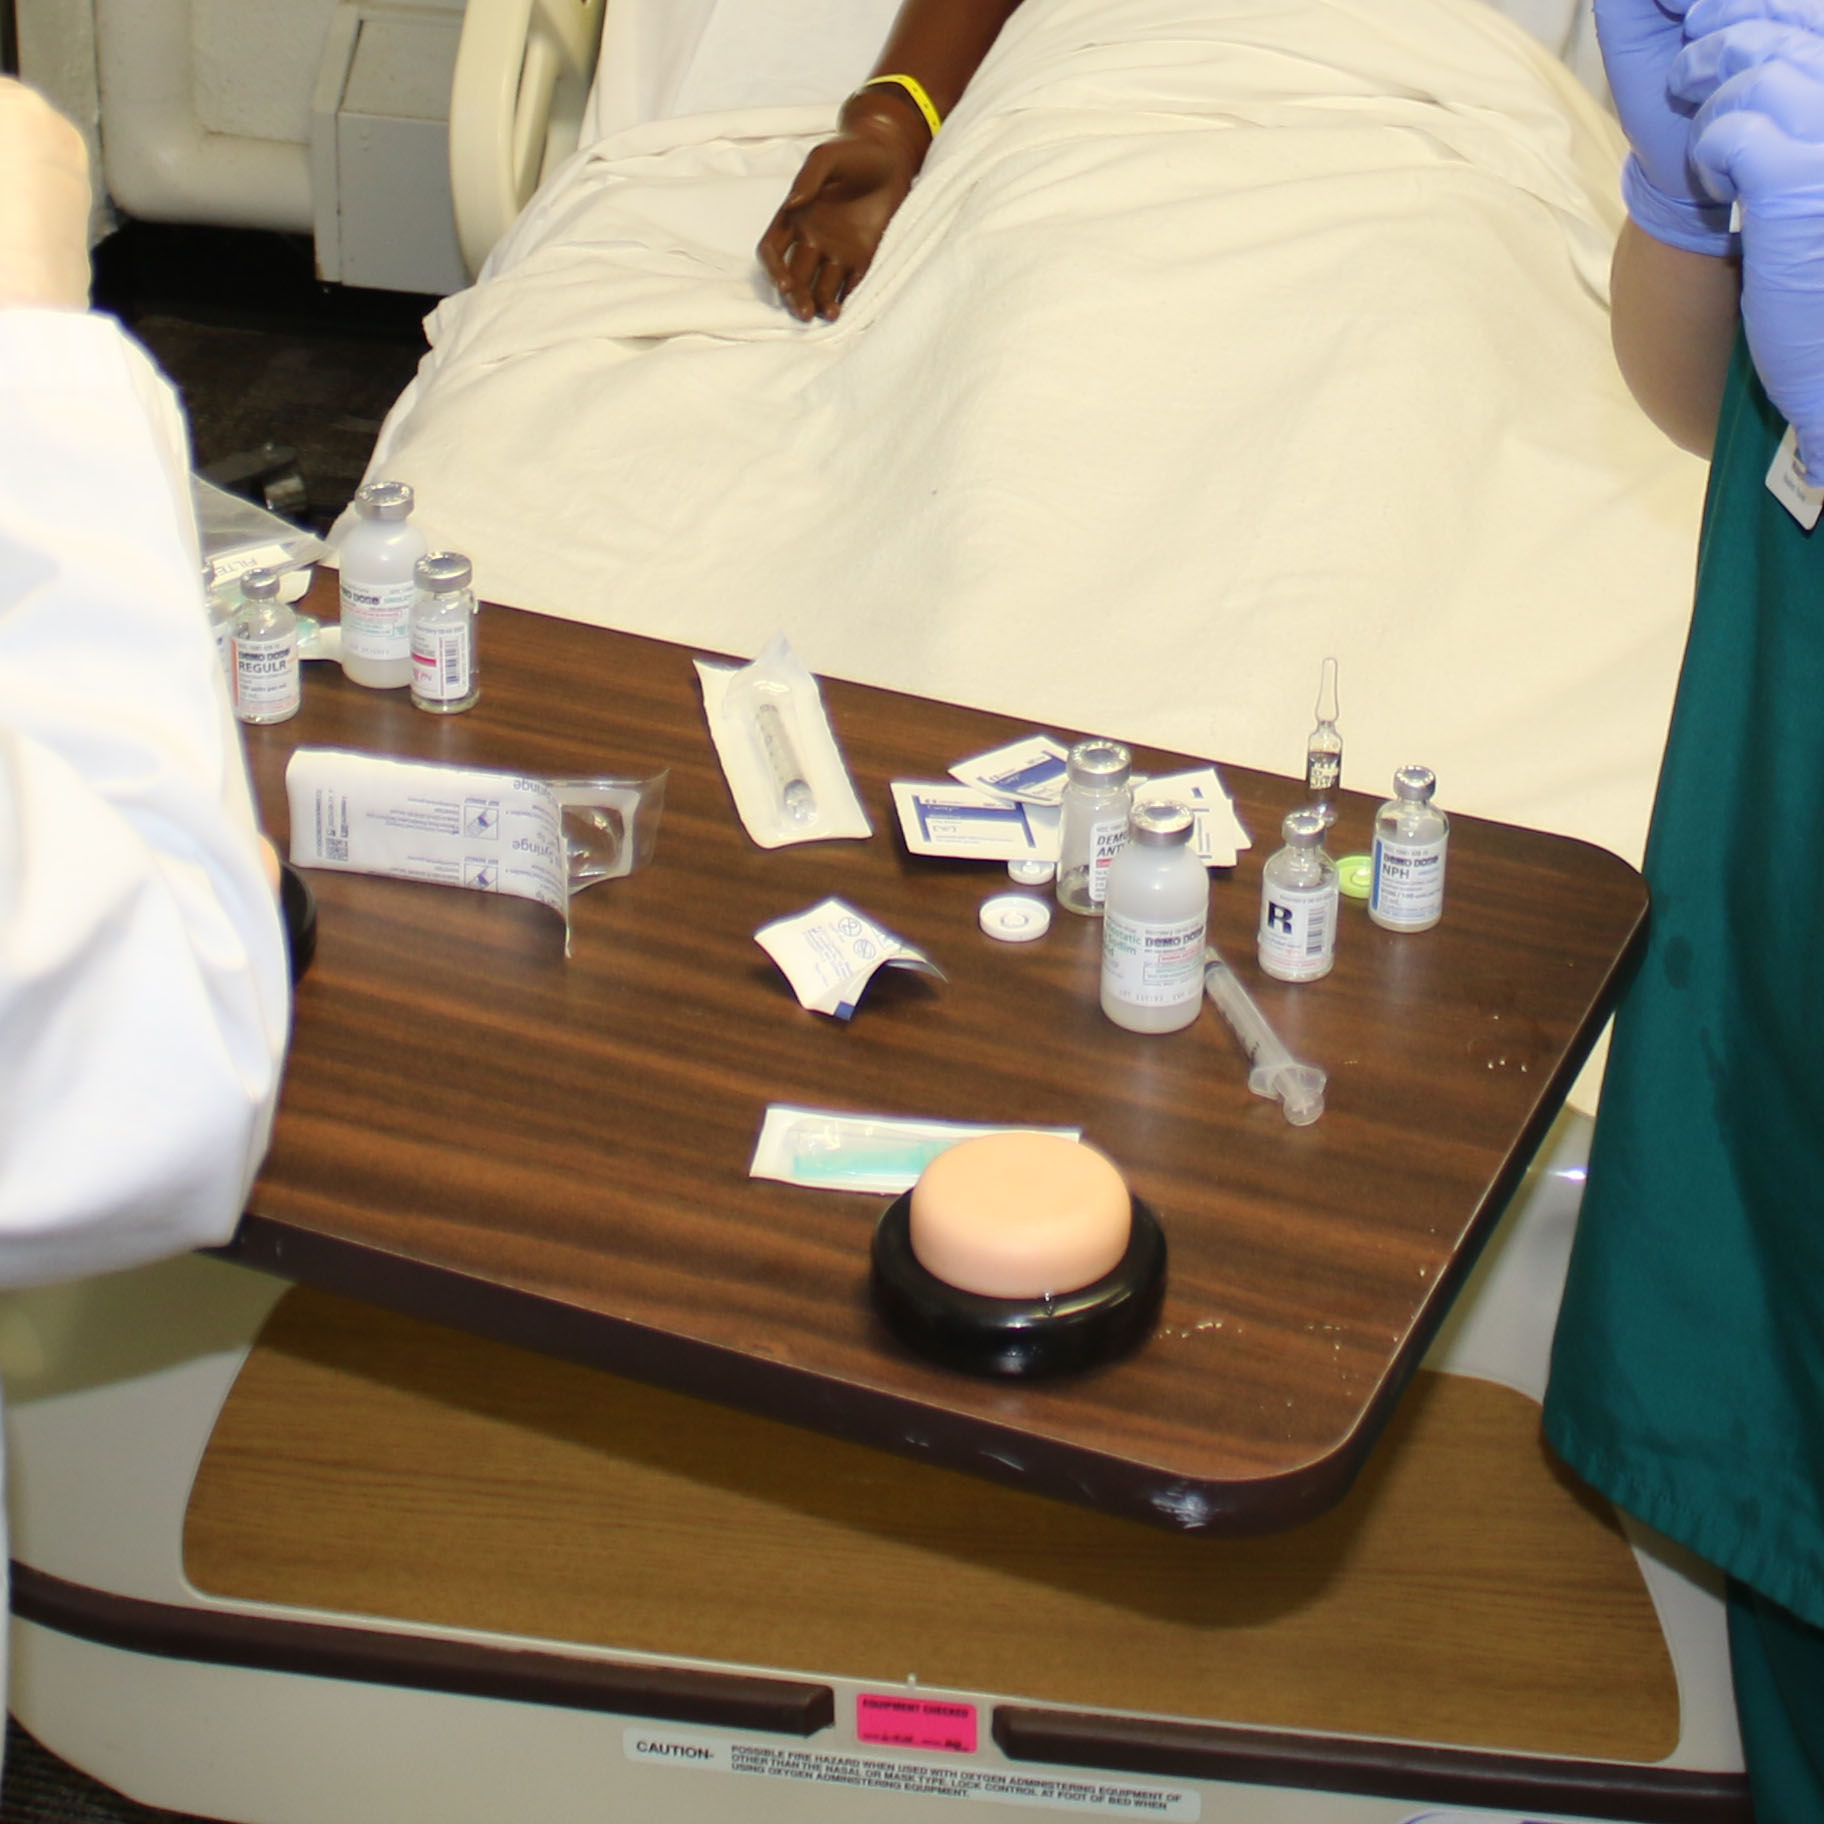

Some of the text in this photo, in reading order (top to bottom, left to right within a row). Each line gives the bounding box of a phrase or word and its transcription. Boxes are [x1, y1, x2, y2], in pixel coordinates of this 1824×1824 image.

[214, 557, 257, 578] FILTE
[238, 659, 287, 674] REGULR
[1382, 863, 1410, 880] NPH
[1267, 900, 1294, 935] R
[635, 1740, 715, 1761] CAUTION-
[731, 1744, 1182, 1803] POSSIBLE FIRE HAZARD WHEN USED WITH OXYGEN ADMINISTERING EQUIPMENT OF
[731, 1763, 971, 1799] USING OXYGEN ADMINISTERING EQUIPMENT.
[731, 1754, 769, 1767] OTHER
[770, 1759, 799, 1771] THAN
[801, 1762, 823, 1774] THE
[825, 1765, 862, 1778] NASAL
[865, 1771, 882, 1781] OR
[883, 1773, 918, 1785] MASK
[951, 1779, 981, 1790] LOCK
[984, 1783, 1039, 1797] CONTROL
[1040, 1788, 1055, 1799] AT
[1057, 1790, 1088, 1802] FOOT
[1089, 1793, 1106, 1804] OF
[1108, 1795, 1132, 1807] BED
[1133, 1799, 1168, 1811] WHEN
